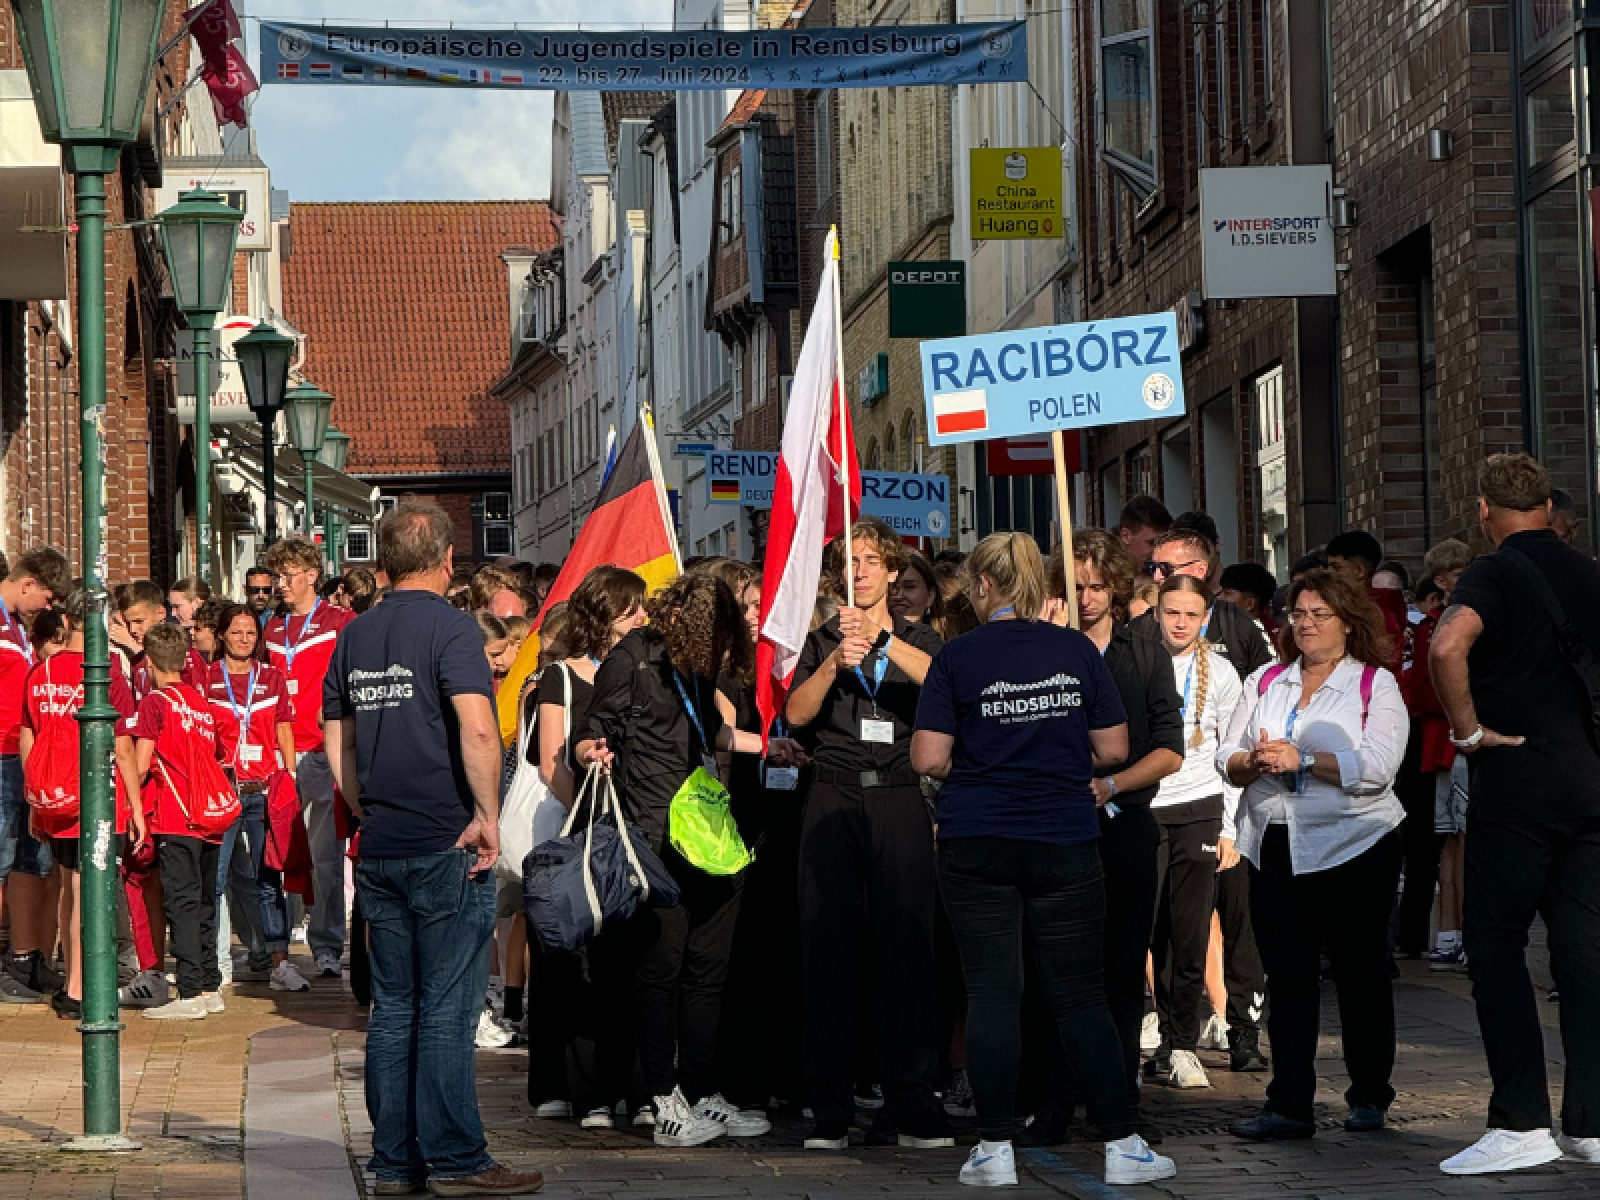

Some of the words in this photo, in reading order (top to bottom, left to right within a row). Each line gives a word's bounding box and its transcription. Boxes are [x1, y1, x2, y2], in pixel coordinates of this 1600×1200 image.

[325, 31, 523, 60] Europäische
[532, 36, 741, 63] Jugendspiele
[751, 35, 780, 57] in
[789, 33, 962, 57] Rendsburg
[538, 66, 570, 84] 22.
[576, 66, 609, 84] bis
[615, 66, 648, 84] 27.
[658, 66, 694, 84] Juli
[700, 66, 751, 84] 2024
[996, 185, 1037, 197] China
[977, 198, 1055, 211] Restaurant
[980, 217, 1039, 236] Huang
[1227, 217, 1322, 232] INTERSPORT
[891, 271, 961, 284] DEPOT
[930, 324, 1171, 391] RACIBÓRZ
[1029, 391, 1101, 422] POLEN
[860, 475, 946, 503] RZON
[981, 691, 1082, 717] RENDSBURG
